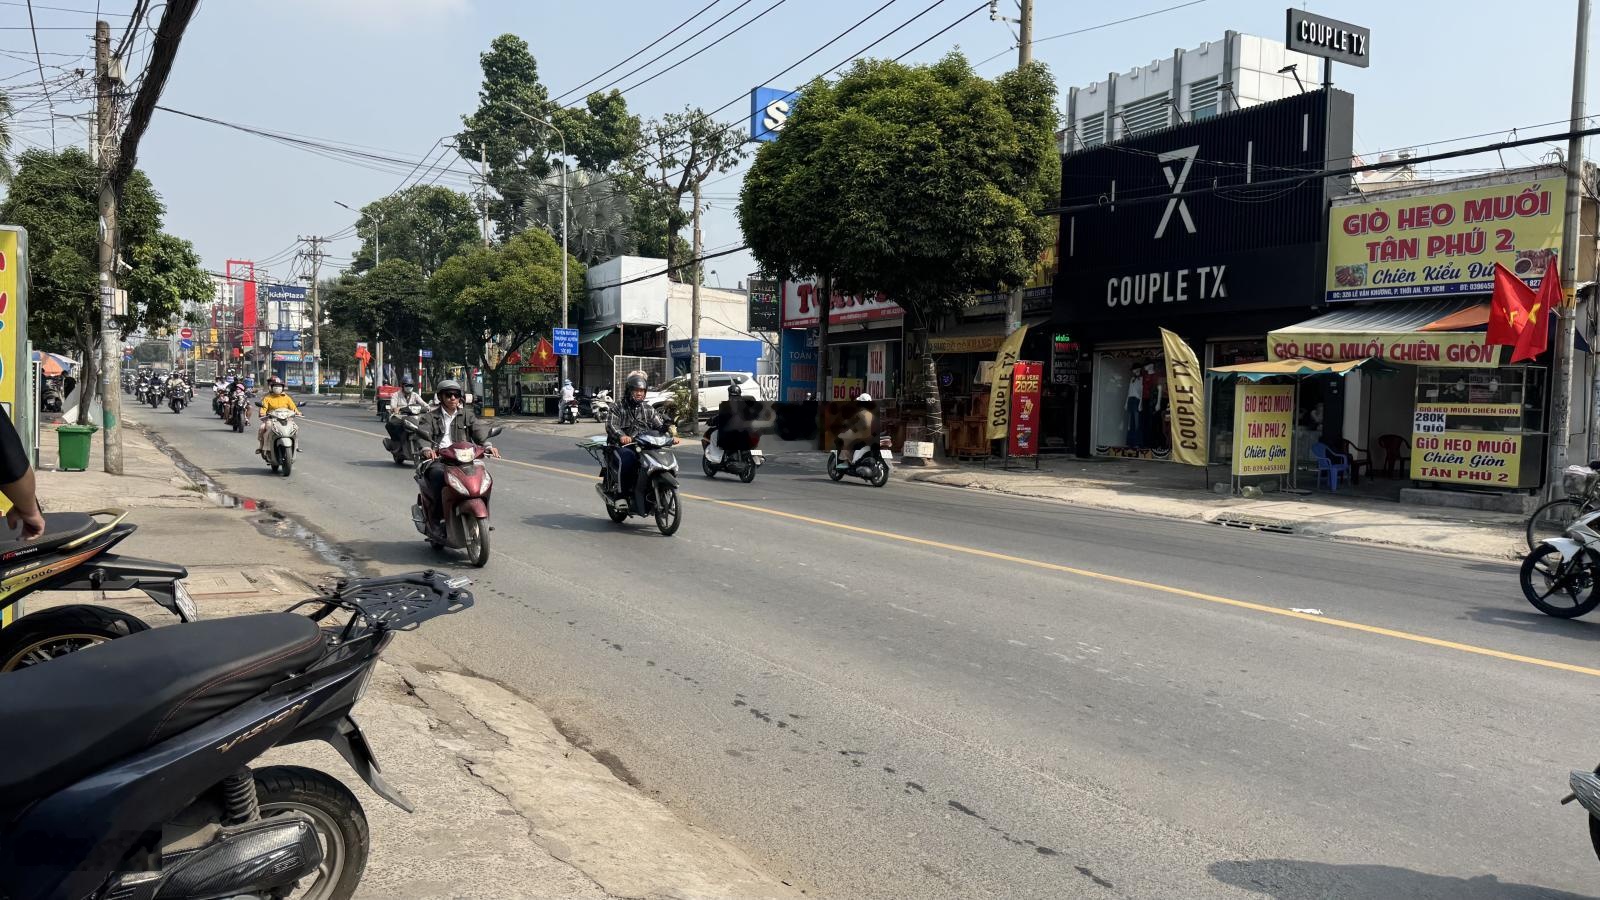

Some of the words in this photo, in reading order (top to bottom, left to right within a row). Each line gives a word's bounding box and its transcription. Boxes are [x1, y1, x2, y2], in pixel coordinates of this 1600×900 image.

[1301, 20, 1348, 50] COUPLE
[1352, 33, 1366, 55] TX
[1343, 208, 1390, 236] GIÒ
[1397, 203, 1455, 231] HEO
[1463, 184, 1551, 223] MUỐI
[1366, 236, 1420, 263] TÂN
[1426, 227, 1486, 258] PHÚ
[1495, 228, 1514, 252] 2
[1372, 264, 1416, 285] Chiên
[1422, 261, 1461, 281] Kiểu
[1468, 261, 1497, 279] Đứ
[1106, 268, 1189, 307] COUPLE
[1197, 265, 1228, 299] TX
[1303, 343, 1334, 363] HEO
[1389, 340, 1441, 362] CHIÊN
[1171, 358, 1192, 379] TX
[1015, 381, 1039, 393] 2025
[1258, 395, 1272, 412] HEO
[1174, 384, 1198, 450] COUPLE
[1415, 413, 1445, 422] 280K
[1281, 423, 1287, 438] 2
[1244, 445, 1266, 459] Chiên
[1443, 438, 1472, 452] HEO
[1477, 436, 1517, 454] MUỐI
[1423, 452, 1464, 464] Chiên
[1469, 454, 1506, 468] Giòn
[1420, 466, 1452, 478] TÂN
[1457, 469, 1492, 481] PHÚ
[1497, 473, 1509, 482] 2
[23, 568, 53, 583] 2006
[216, 699, 309, 754] VISION
